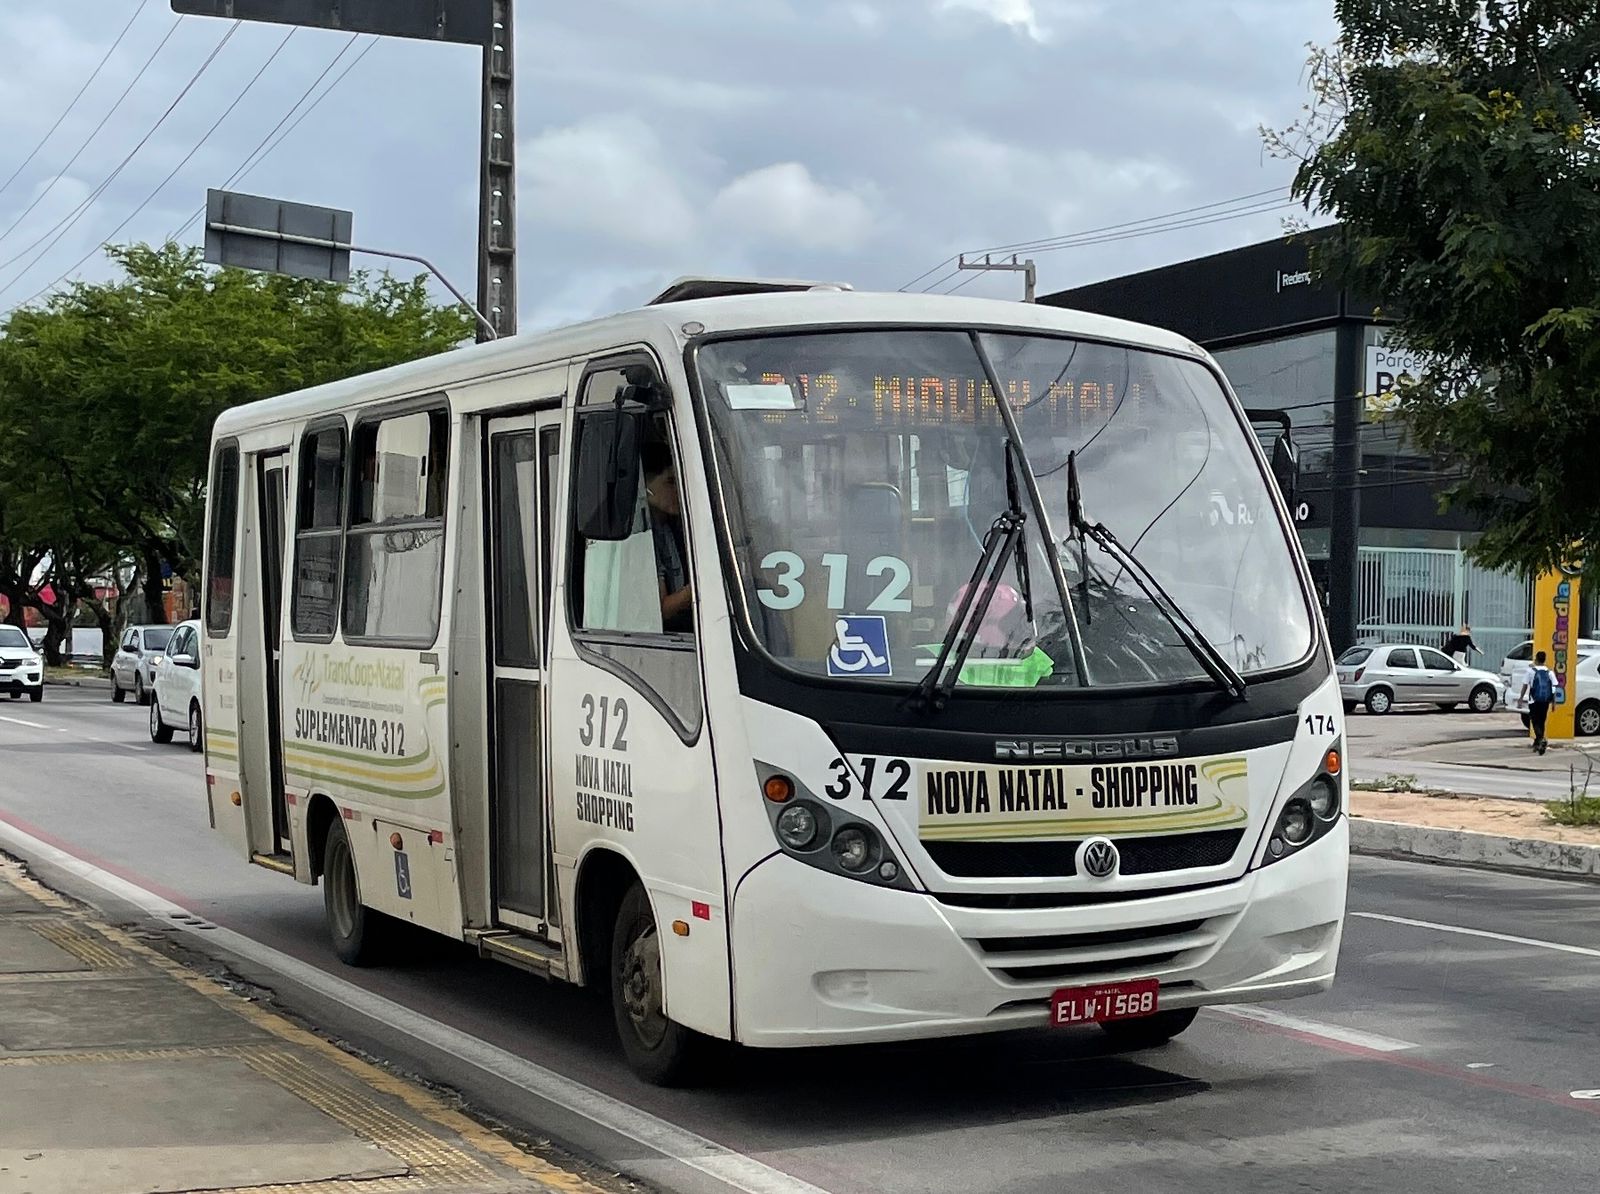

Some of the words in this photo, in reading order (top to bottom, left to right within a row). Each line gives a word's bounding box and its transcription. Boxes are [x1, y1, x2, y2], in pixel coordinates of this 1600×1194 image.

[757, 551, 912, 613] 312
[295, 707, 377, 752] SUPLEMENTAR
[381, 720, 405, 757] 312
[579, 693, 629, 752] 312
[1305, 714, 1335, 736] 174
[995, 736, 1180, 759] NEOBUS
[575, 753, 601, 792] NOVA
[602, 758, 633, 798] NATAL
[825, 757, 912, 801] 312
[926, 770, 991, 815] NOVA
[999, 768, 1068, 812] NATAL
[1091, 764, 1199, 809] SHOPPING
[576, 791, 635, 832] SHOPPING
